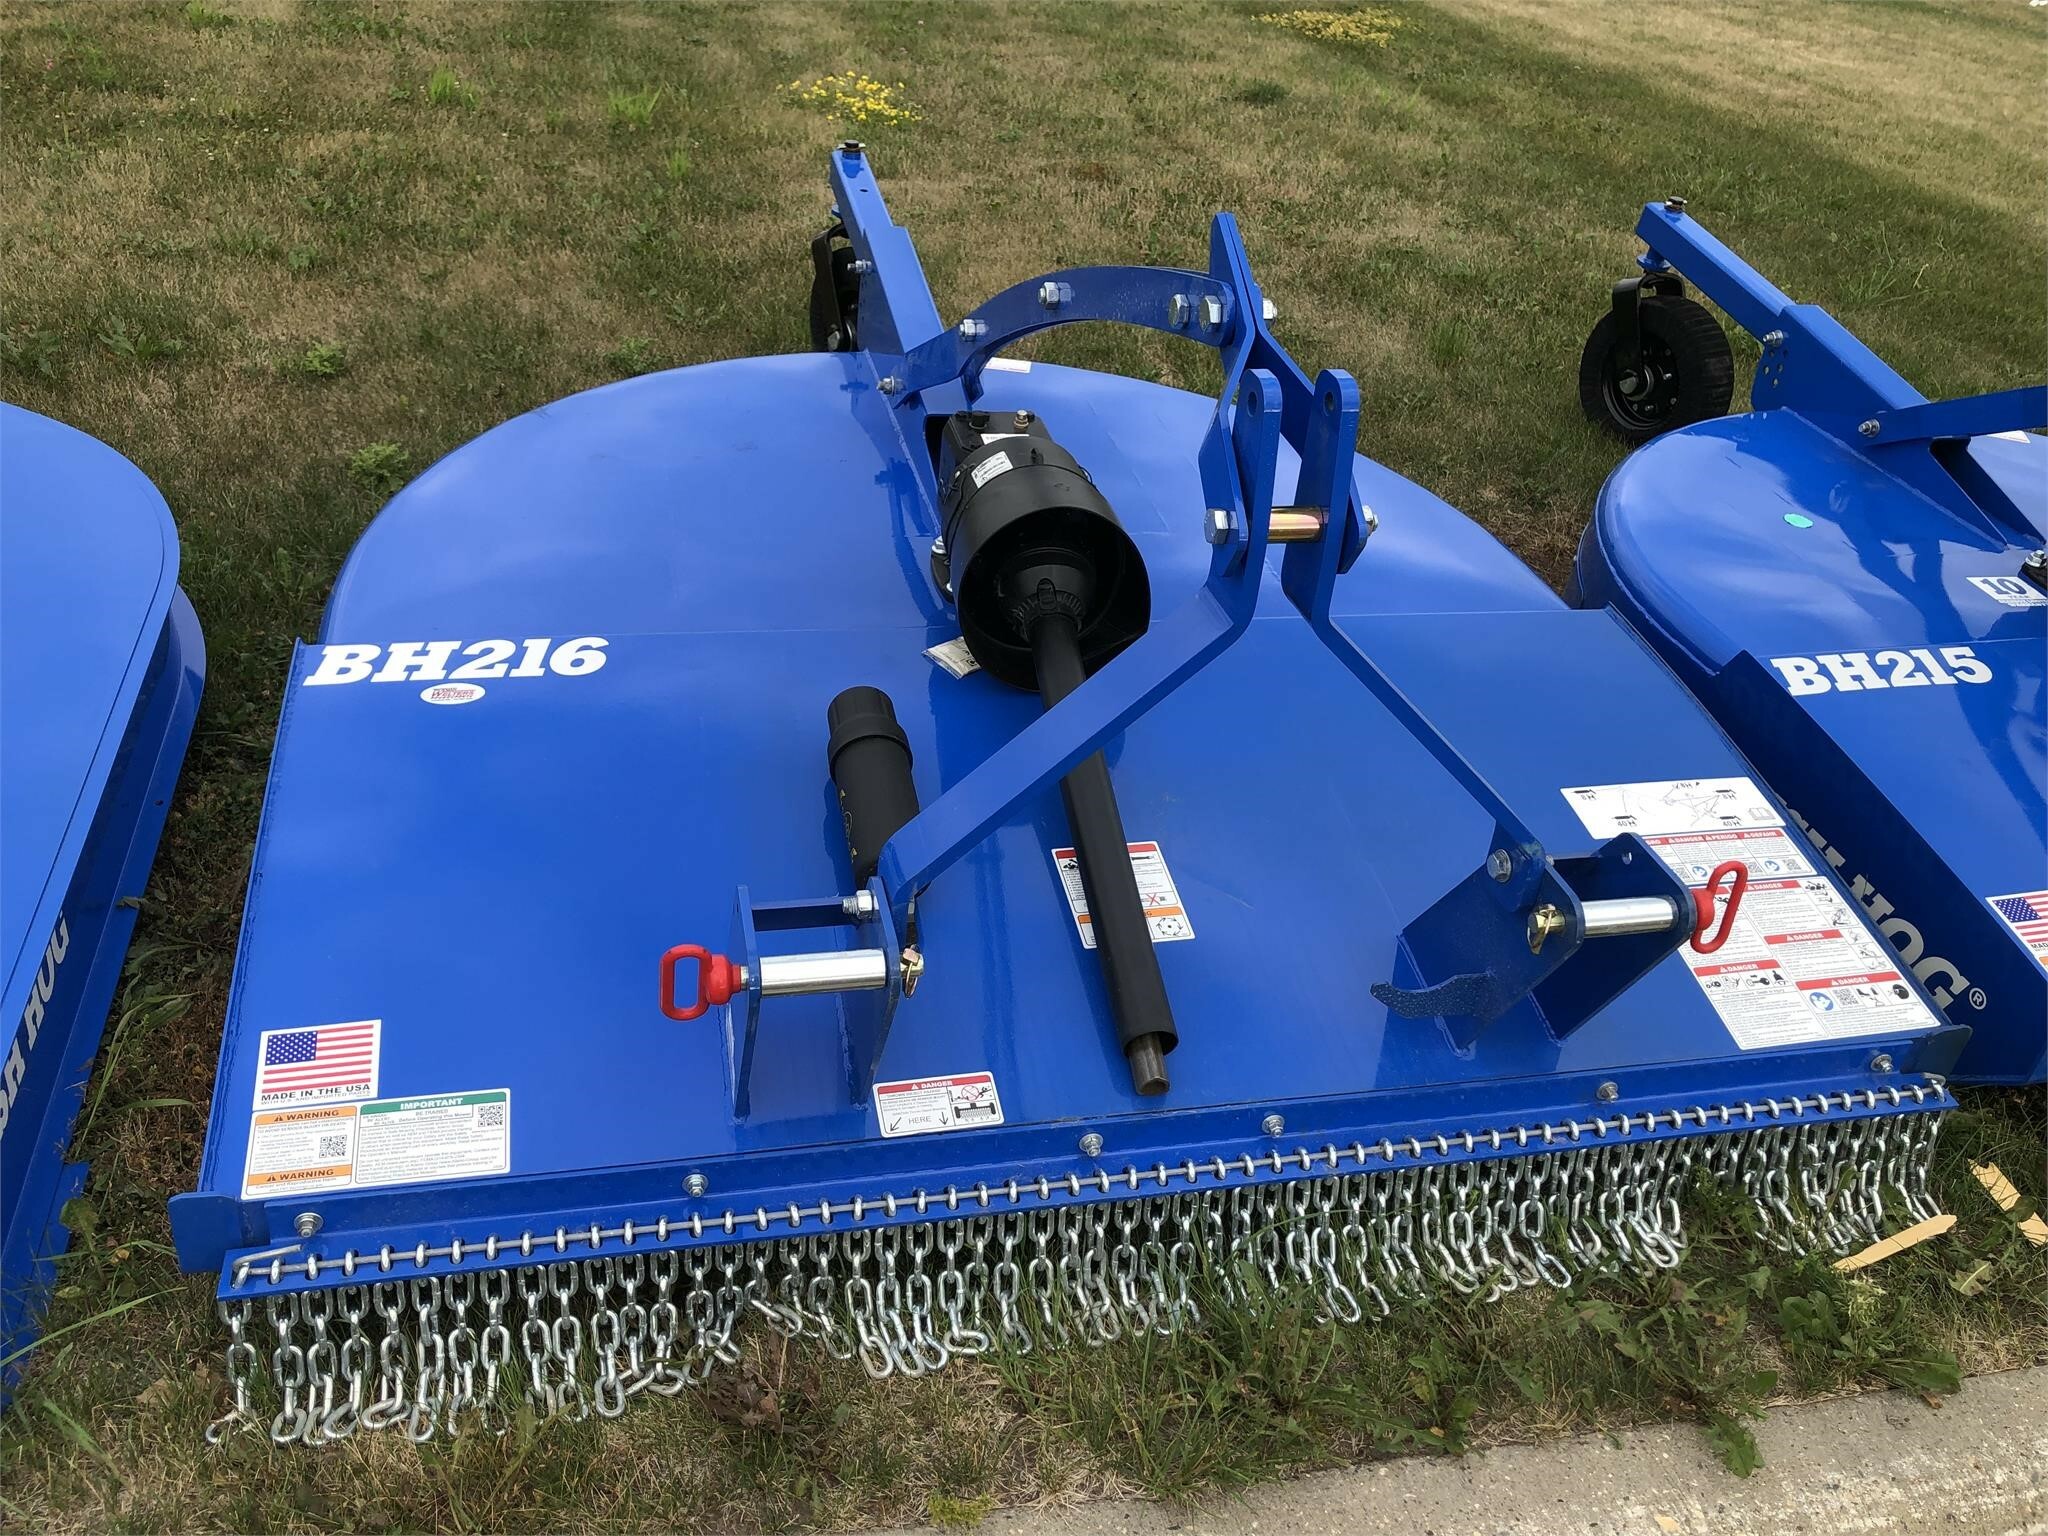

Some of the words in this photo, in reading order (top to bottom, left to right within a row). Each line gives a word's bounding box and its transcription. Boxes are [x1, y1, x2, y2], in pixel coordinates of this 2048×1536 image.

[1980, 578, 2027, 595] 10
[302, 636, 610, 686] BH216
[1769, 646, 1993, 697] BH215
[1753, 882, 1784, 890] DANGER
[1792, 932, 1825, 940] DANGER
[1727, 963, 1759, 972] DANGER
[1837, 976, 1871, 985] DANGER
[920, 1080, 953, 1089] DANGER
[261, 1091, 296, 1101] MADE
[300, 1089, 313, 1097] IN
[318, 1086, 342, 1095] THE
[346, 1083, 371, 1092] USA
[400, 1097, 464, 1110] IMPORTANT
[286, 1110, 340, 1121] WARNING
[908, 1116, 932, 1125] HERE
[279, 1168, 335, 1181] WARNING
